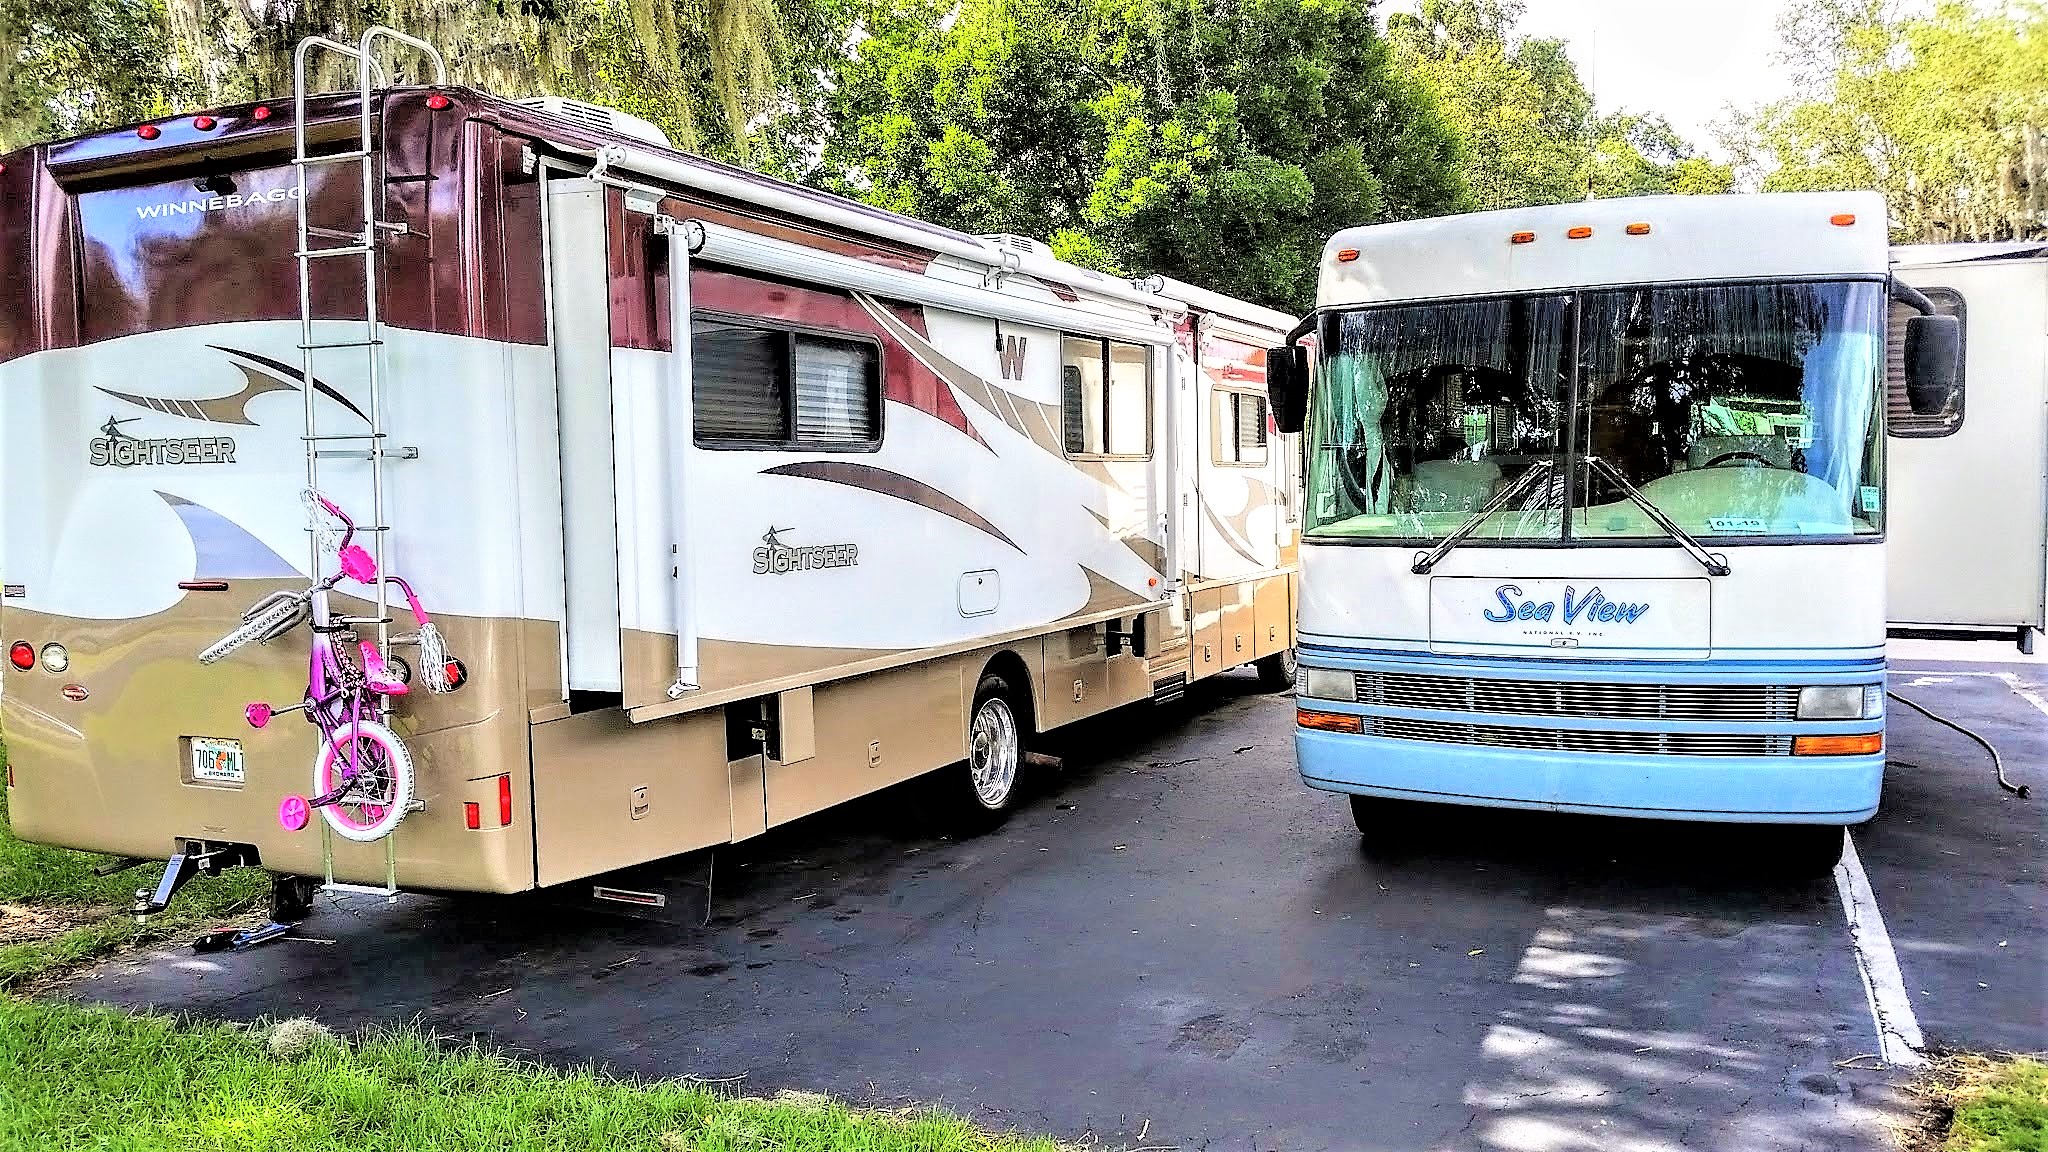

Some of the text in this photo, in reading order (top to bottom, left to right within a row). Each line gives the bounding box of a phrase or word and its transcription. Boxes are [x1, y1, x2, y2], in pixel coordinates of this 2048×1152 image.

[136, 187, 309, 220] WINNEBAGO
[998, 334, 1027, 381] W
[89, 436, 236, 468] SIGHTSEER
[753, 543, 858, 575] SIGHTSEER
[1483, 584, 1650, 625] Sea View
[195, 749, 215, 769] 706
